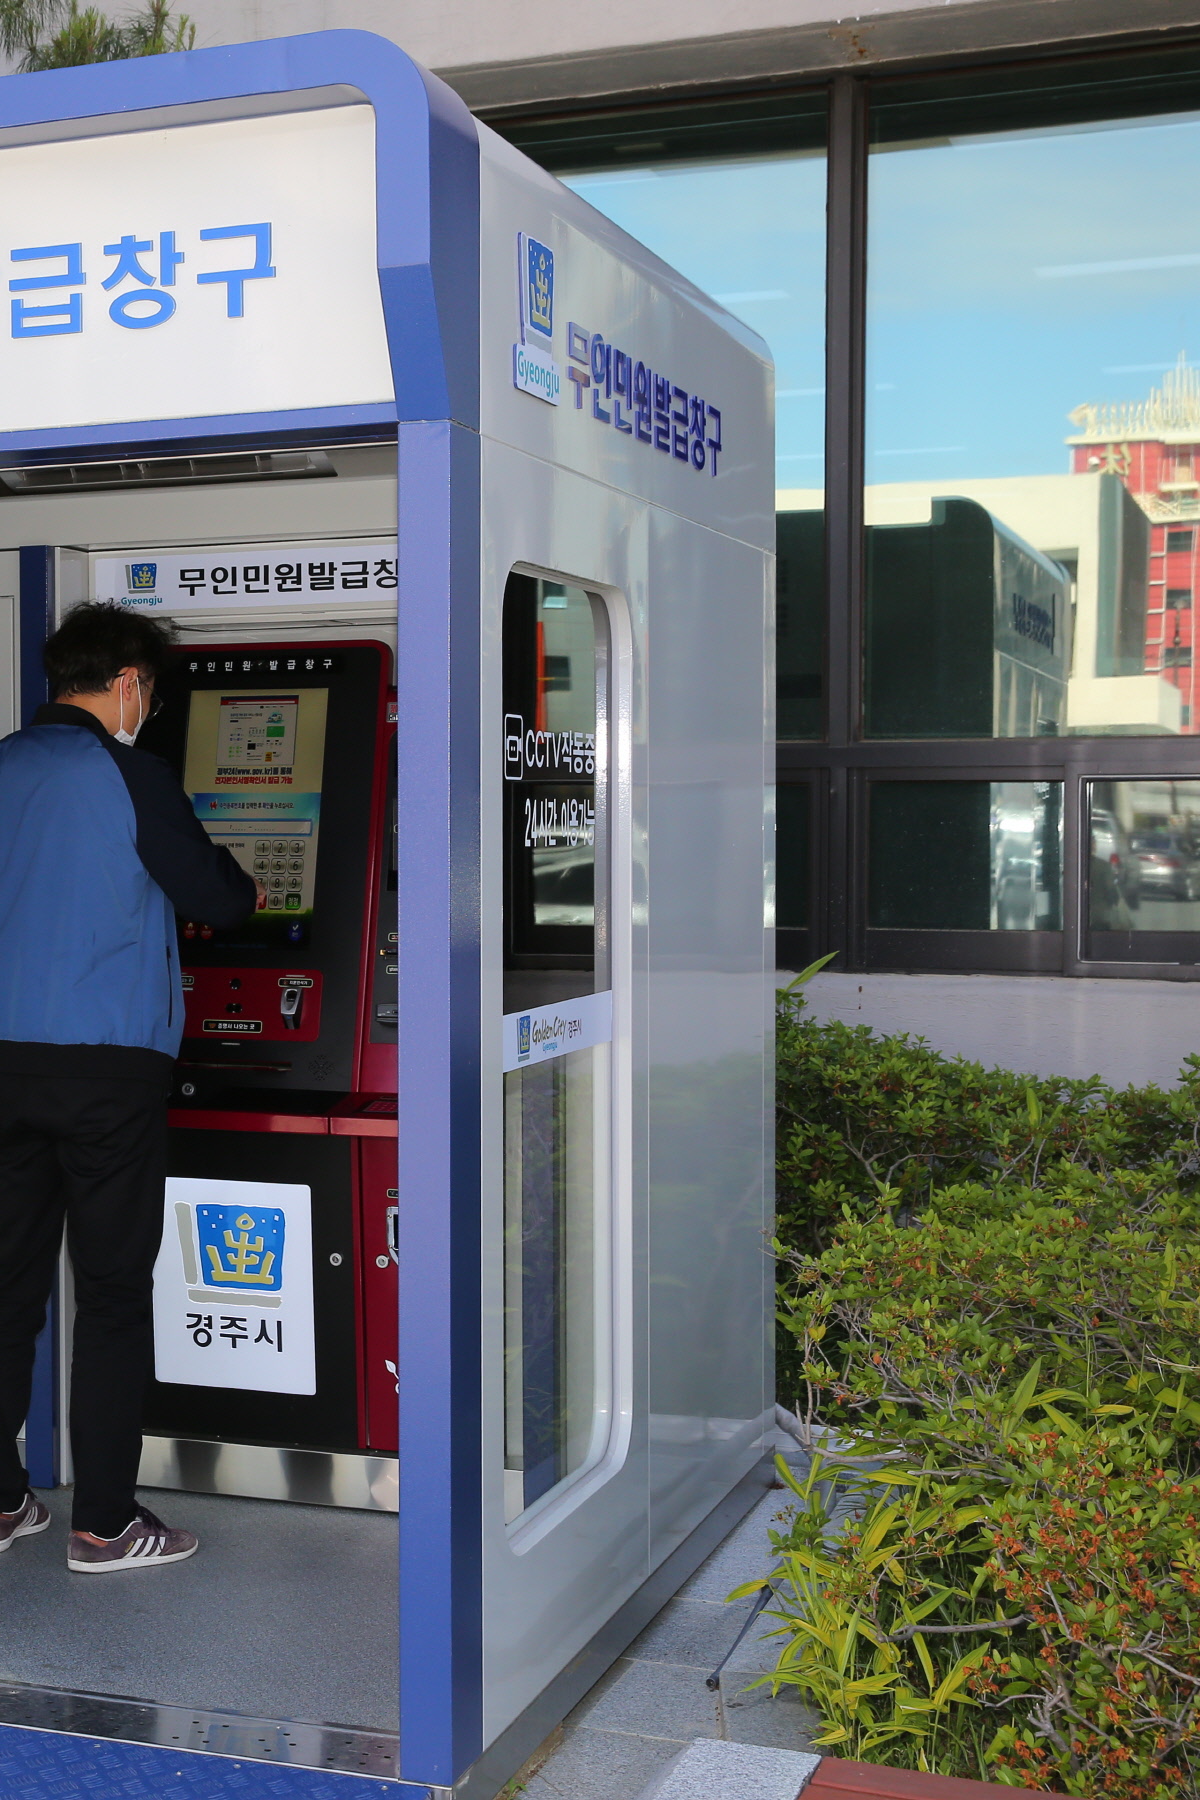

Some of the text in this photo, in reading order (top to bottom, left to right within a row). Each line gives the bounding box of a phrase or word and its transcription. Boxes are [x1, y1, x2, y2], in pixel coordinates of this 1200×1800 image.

[517, 350, 561, 399] Gyeongju
[566, 321, 722, 478] 무인민원발급창구
[120, 596, 163, 606] Gyeongju
[525, 729, 595, 775] CCTV작동중
[524, 797, 595, 848] 24시간 이용가능
[185, 1312, 284, 1353] 경주시
